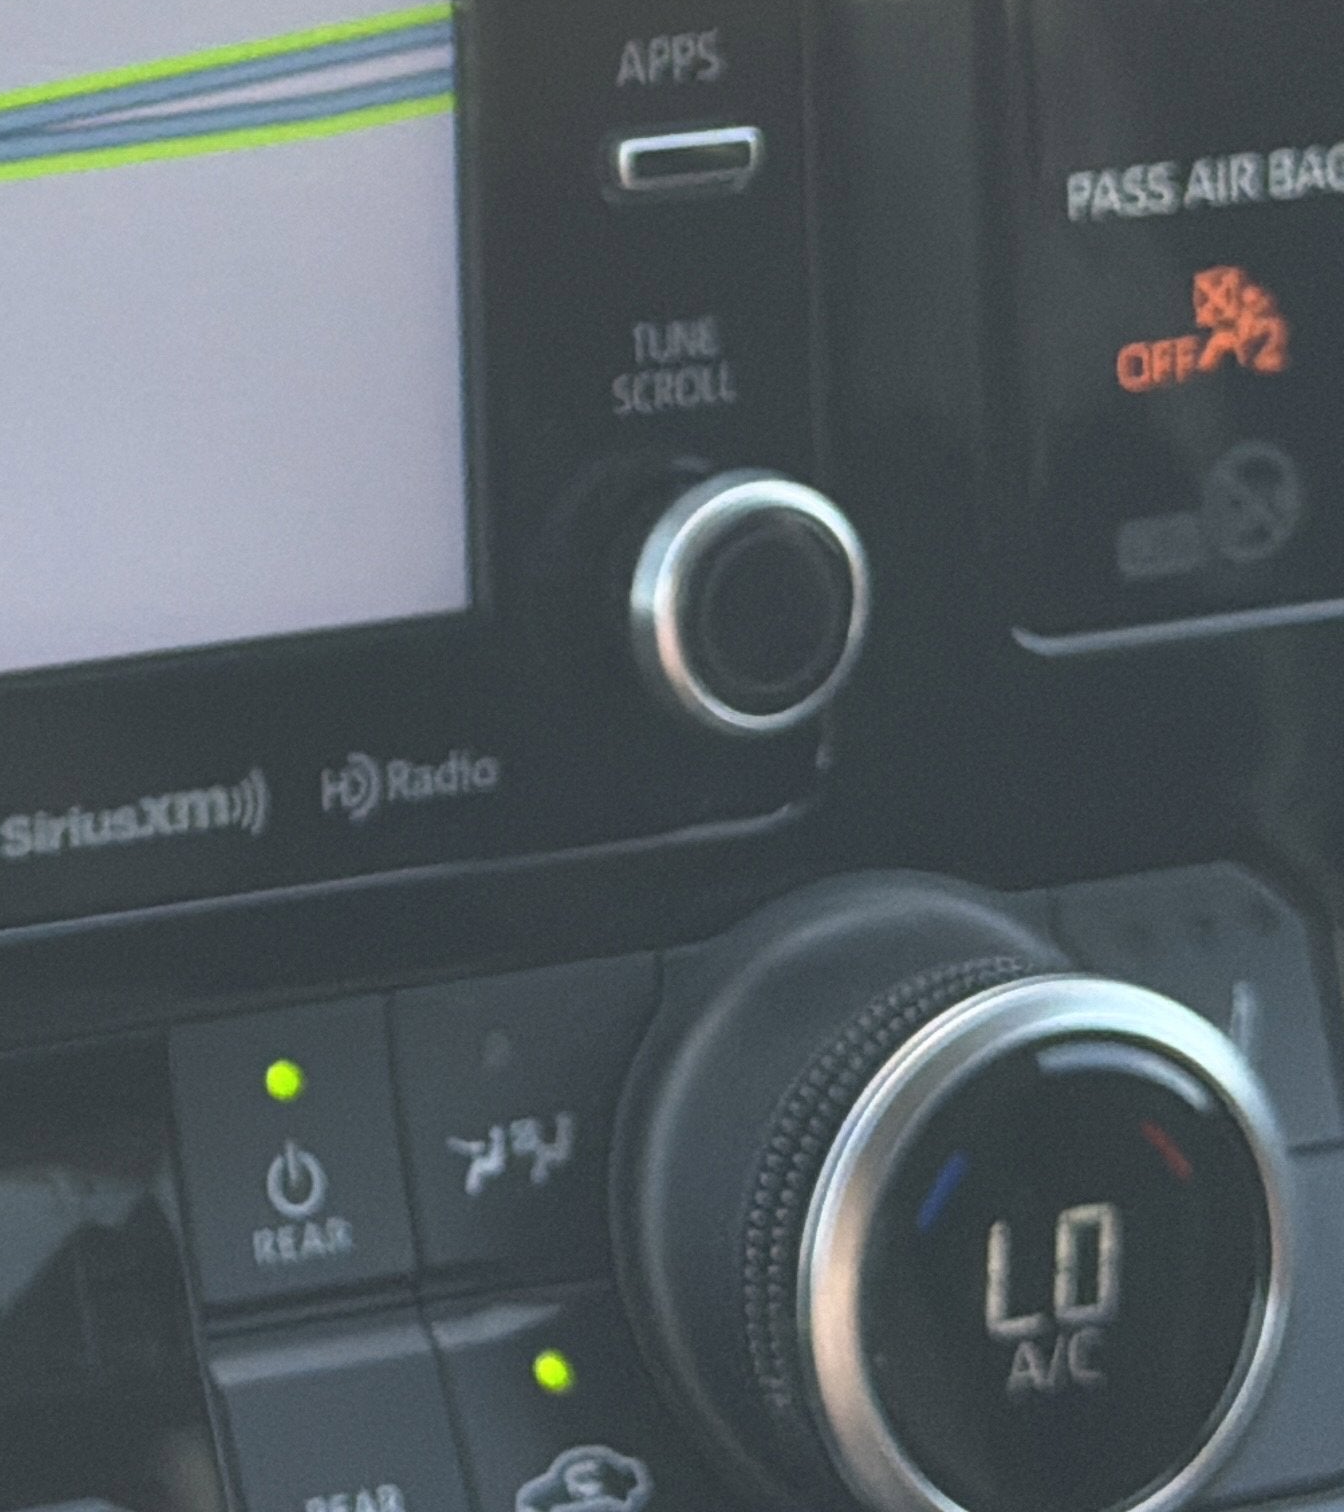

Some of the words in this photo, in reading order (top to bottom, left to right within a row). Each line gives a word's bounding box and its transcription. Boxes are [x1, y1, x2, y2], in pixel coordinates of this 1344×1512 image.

[617, 31, 724, 87] APPS
[1067, 161, 1181, 222] PASS
[1184, 151, 1262, 209] AIR
[633, 316, 718, 364] TUNE
[1116, 334, 1200, 392] OFF
[612, 361, 737, 415] SCROLL
[387, 749, 500, 801] Radio
[252, 1217, 354, 1266] REAR
[1008, 1327, 1106, 1391] A/C
